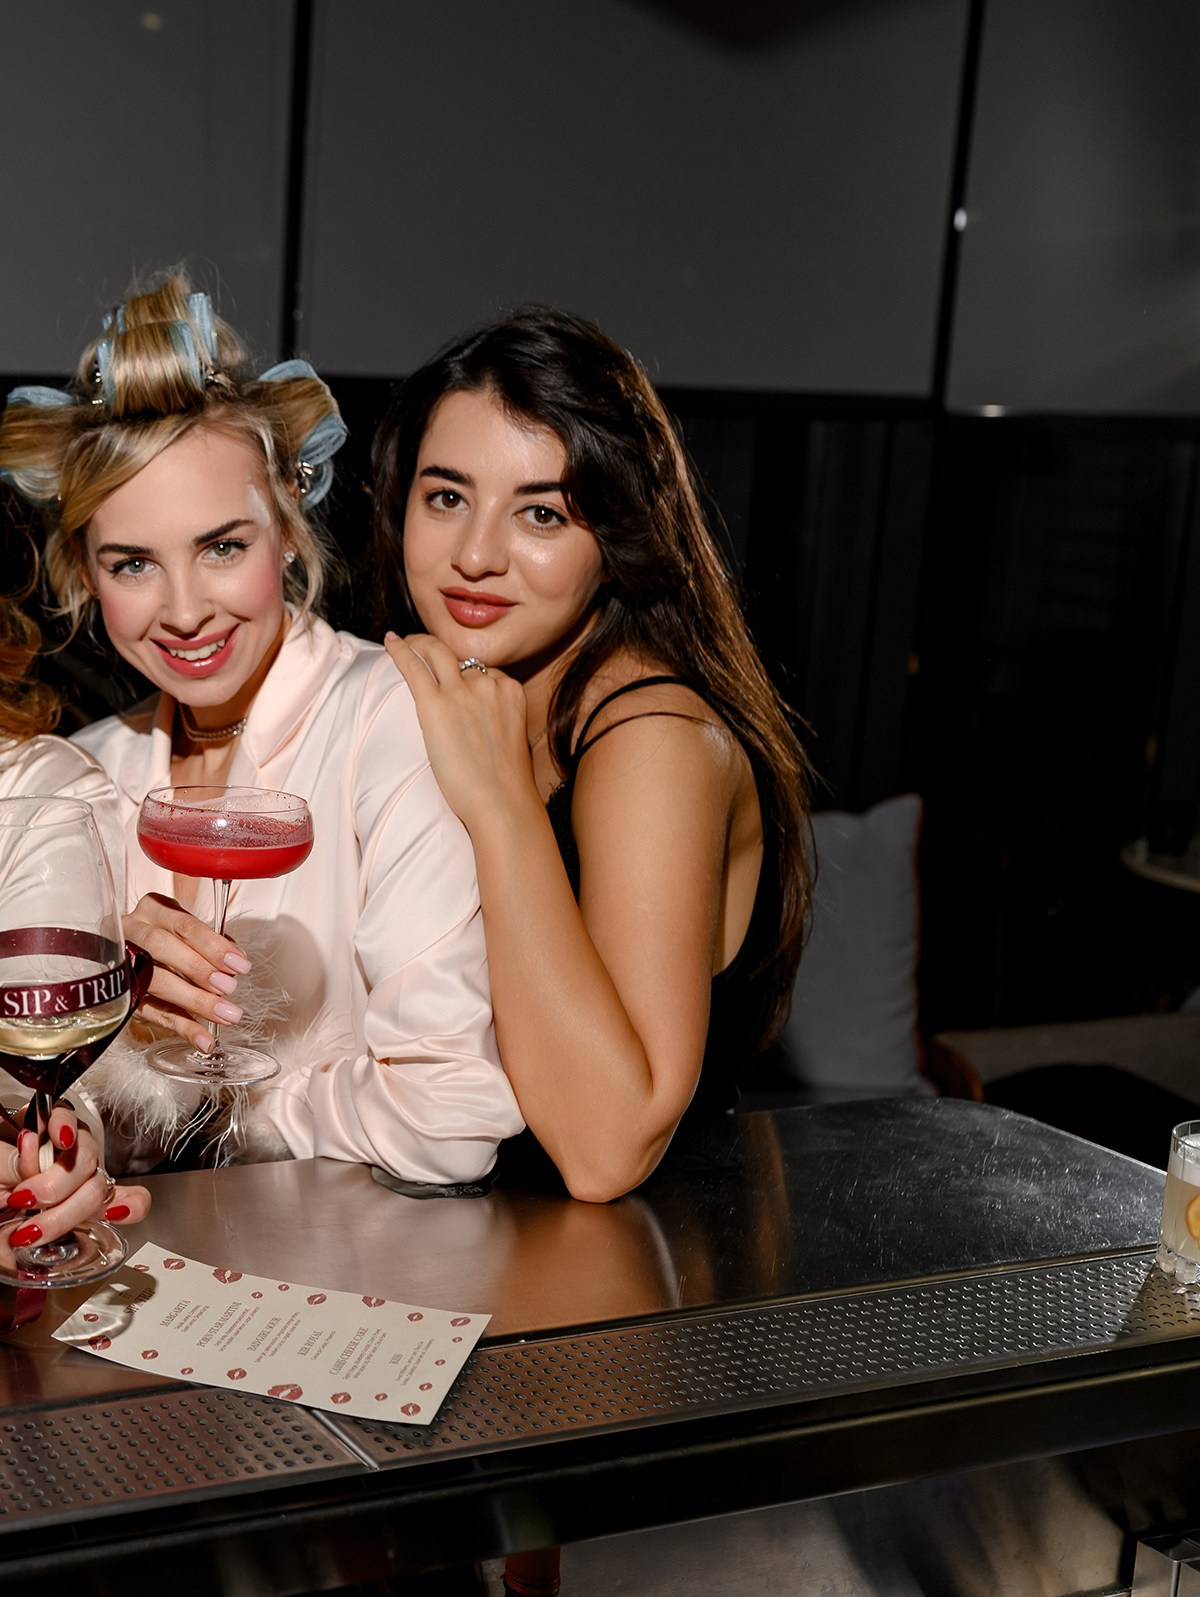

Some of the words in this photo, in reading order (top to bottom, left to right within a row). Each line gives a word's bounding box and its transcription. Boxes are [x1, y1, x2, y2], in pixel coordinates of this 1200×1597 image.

[3, 988, 52, 1017] SIP
[54, 996, 70, 1012] &
[70, 968, 126, 1008] TRIP
[123, 1303, 139, 1316] SIP
[135, 1287, 156, 1303] TRIP
[160, 1299, 191, 1327] MARGARITA
[196, 1332, 214, 1348] PORN
[207, 1321, 224, 1335] STAR
[217, 1301, 242, 1323] MARTINI
[304, 1330, 324, 1348] ROYAL
